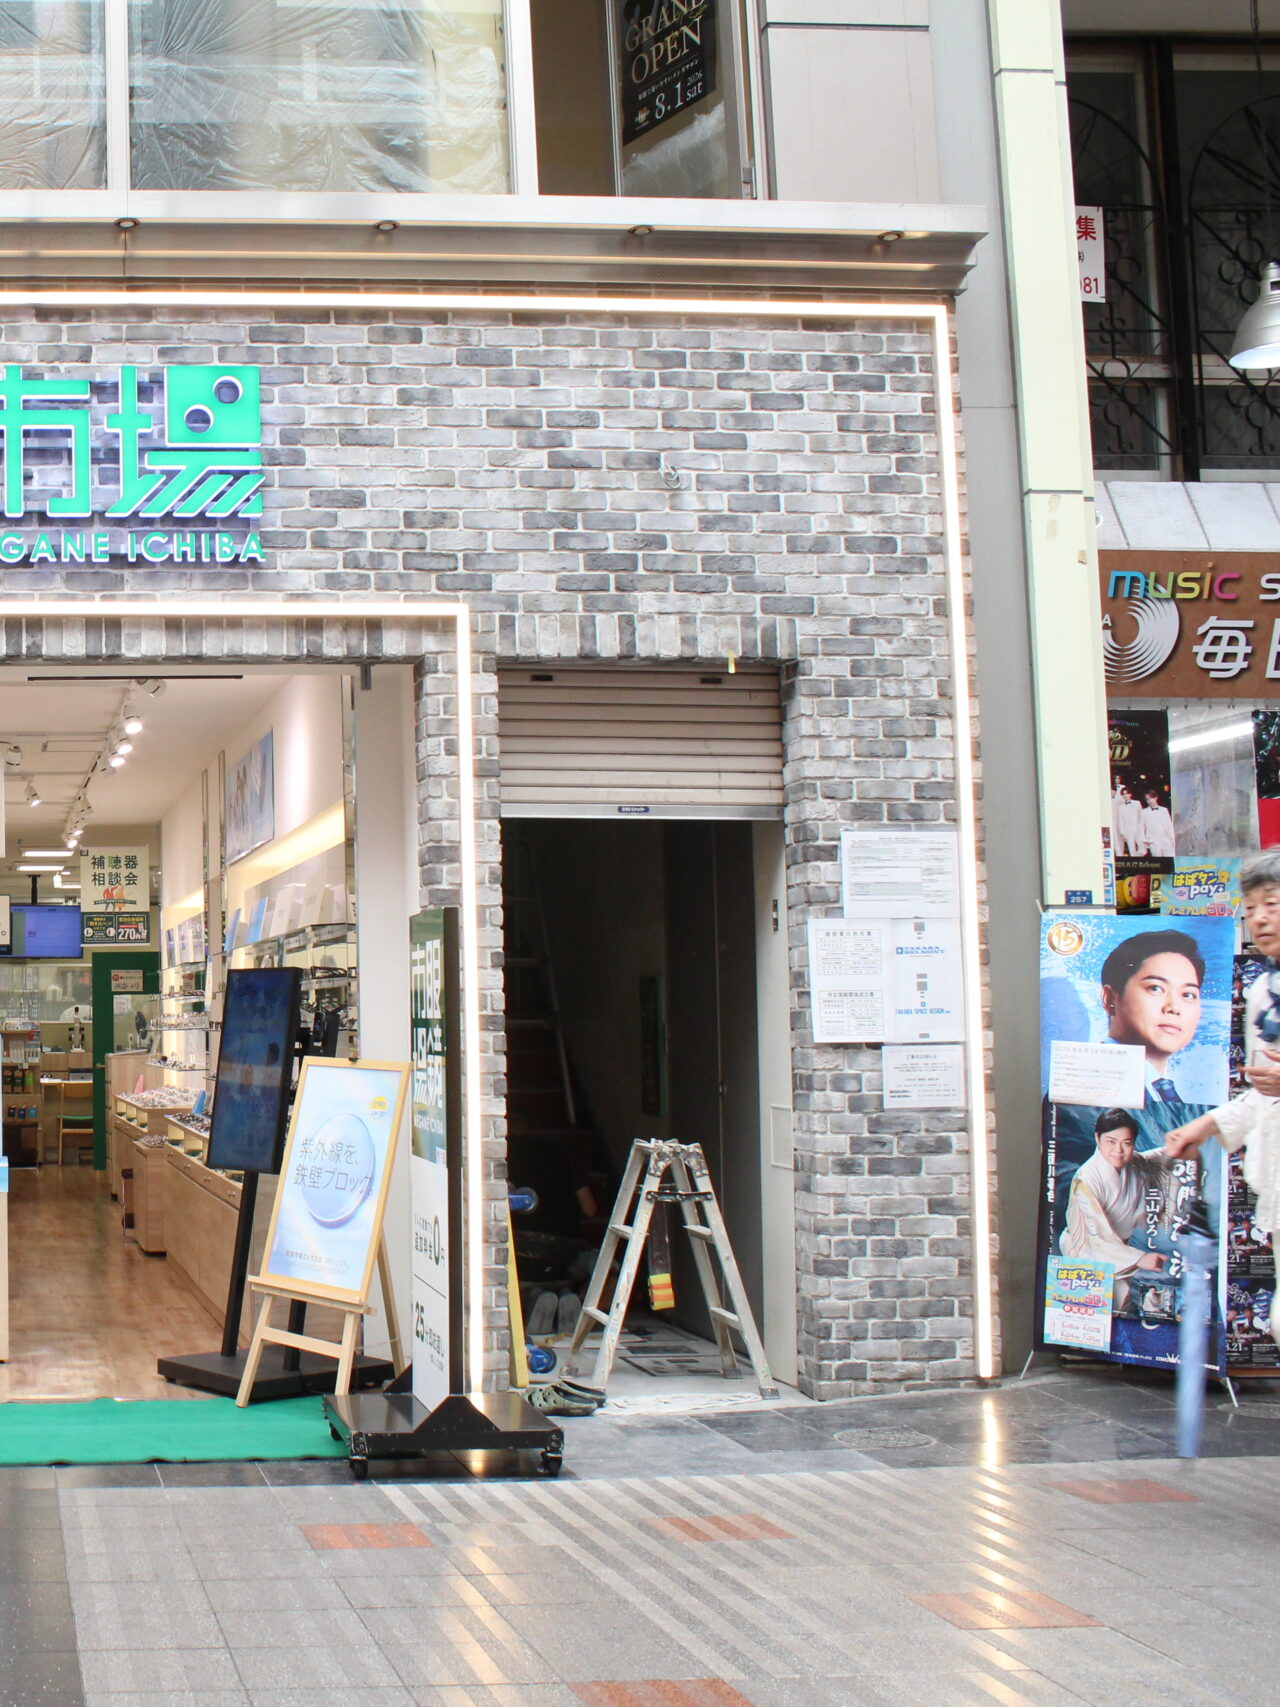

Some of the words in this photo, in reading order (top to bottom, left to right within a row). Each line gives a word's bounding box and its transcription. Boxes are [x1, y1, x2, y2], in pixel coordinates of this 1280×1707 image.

[631, 15, 702, 83] OPEN
[686, 81, 704, 101] sat
[1076, 215, 1097, 241] 集
[1080, 276, 1099, 295] 81
[128, 530, 266, 563] ICHIBA
[1107, 561, 1241, 600] music
[91, 855, 138, 870] 補聴器
[92, 871, 138, 886] 相談会
[299, 1136, 359, 1166] 紫外線を、
[293, 1164, 373, 1197] 鉄壁ブロック。
[1145, 1188, 1161, 1250] 三山ひろし
